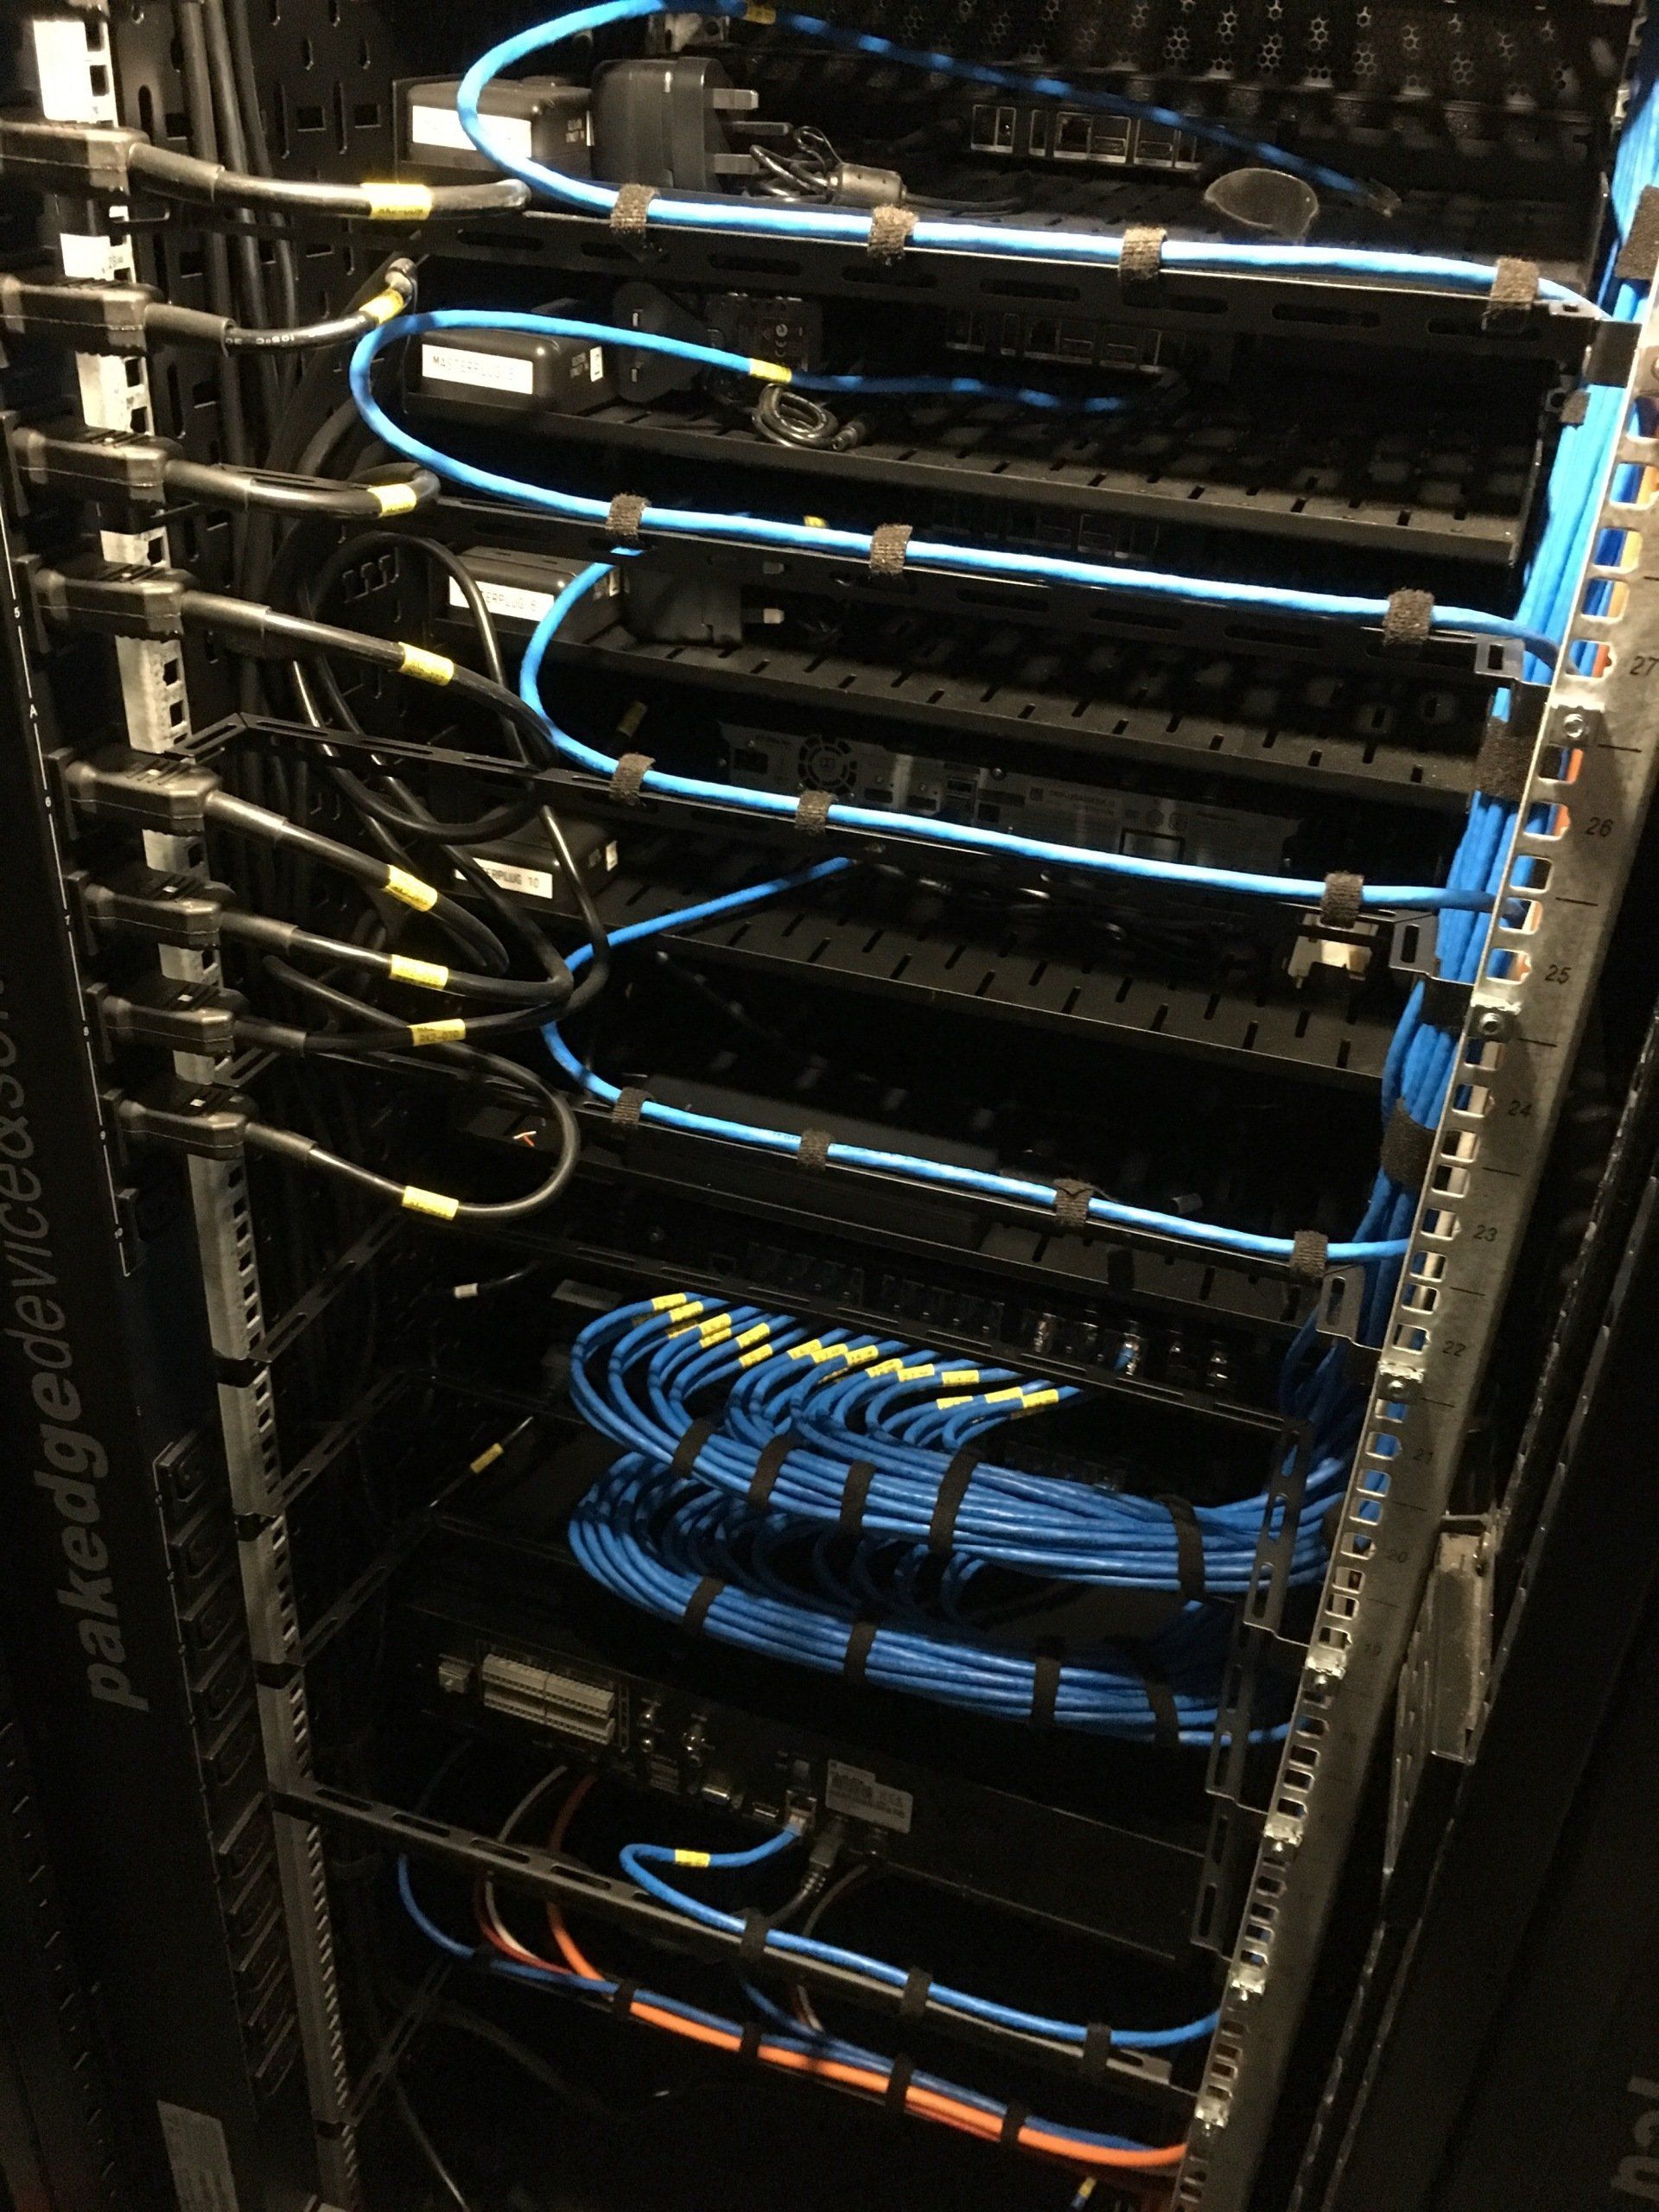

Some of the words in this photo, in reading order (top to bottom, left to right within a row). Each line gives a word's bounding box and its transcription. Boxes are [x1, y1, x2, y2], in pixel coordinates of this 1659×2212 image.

[1630, 655, 1659, 676] 27
[1585, 817, 1613, 838] 26
[1545, 964, 1573, 983] 25
[1508, 1100, 1532, 1119] 24
[1473, 1224, 1498, 1243] 23
[1442, 1340, 1466, 1357] 22
